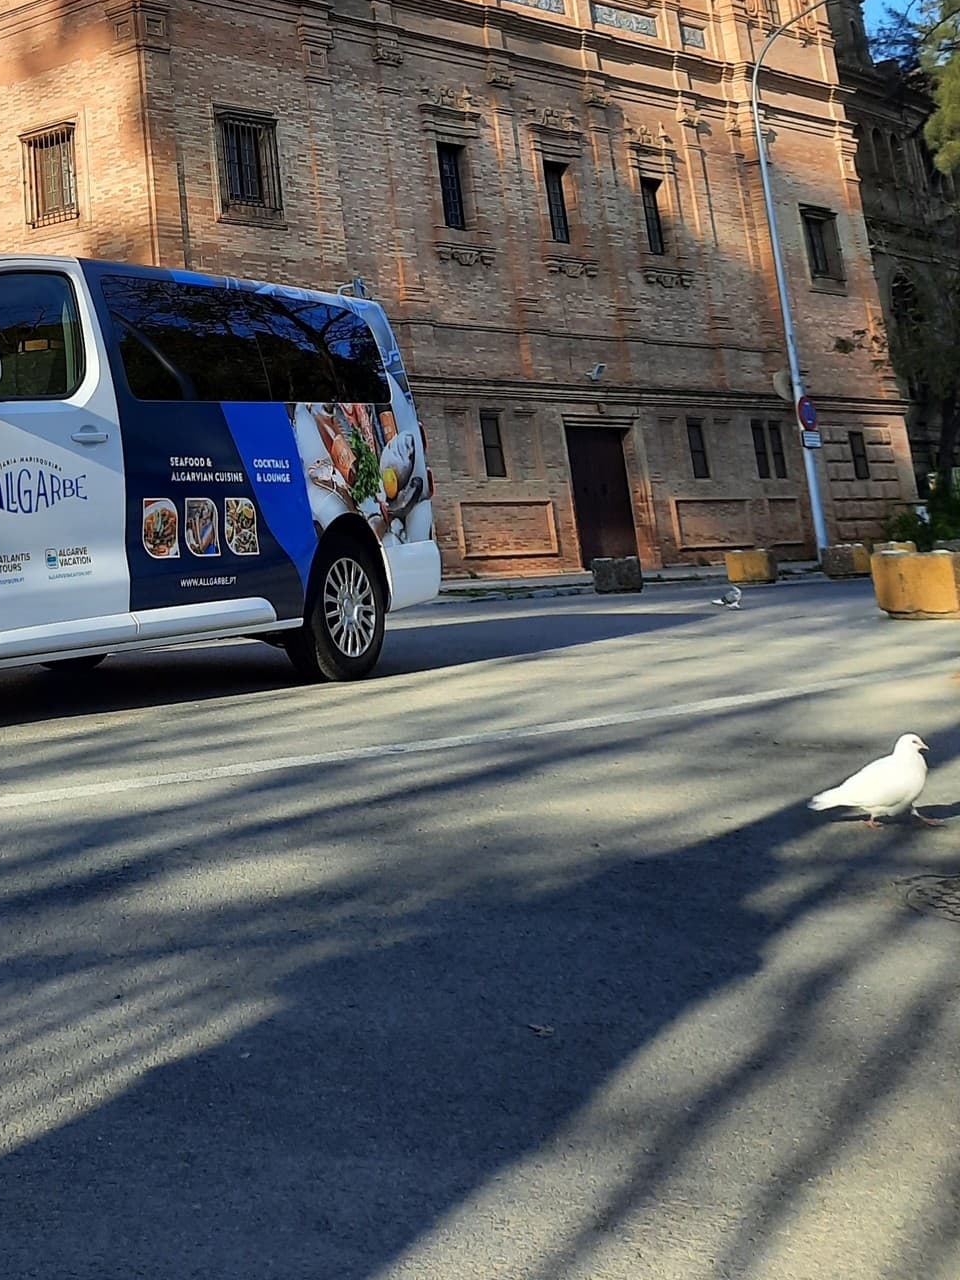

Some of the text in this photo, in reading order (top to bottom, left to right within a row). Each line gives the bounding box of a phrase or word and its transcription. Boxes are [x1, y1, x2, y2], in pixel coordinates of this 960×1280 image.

[20, 456, 62, 472] MARISQUEIRA
[169, 457, 213, 467] SEAFOOD &
[253, 459, 290, 469] COCKTAILS
[171, 471, 244, 482] ALGARVIAN CUISINE
[256, 473, 291, 483] & LOUNGE
[58, 546, 88, 557] ALGARVE
[59, 556, 92, 567] VACATION
[0, 563, 22, 574] TOURS
[180, 576, 237, 588] WWW.ALLGARBE.PT
